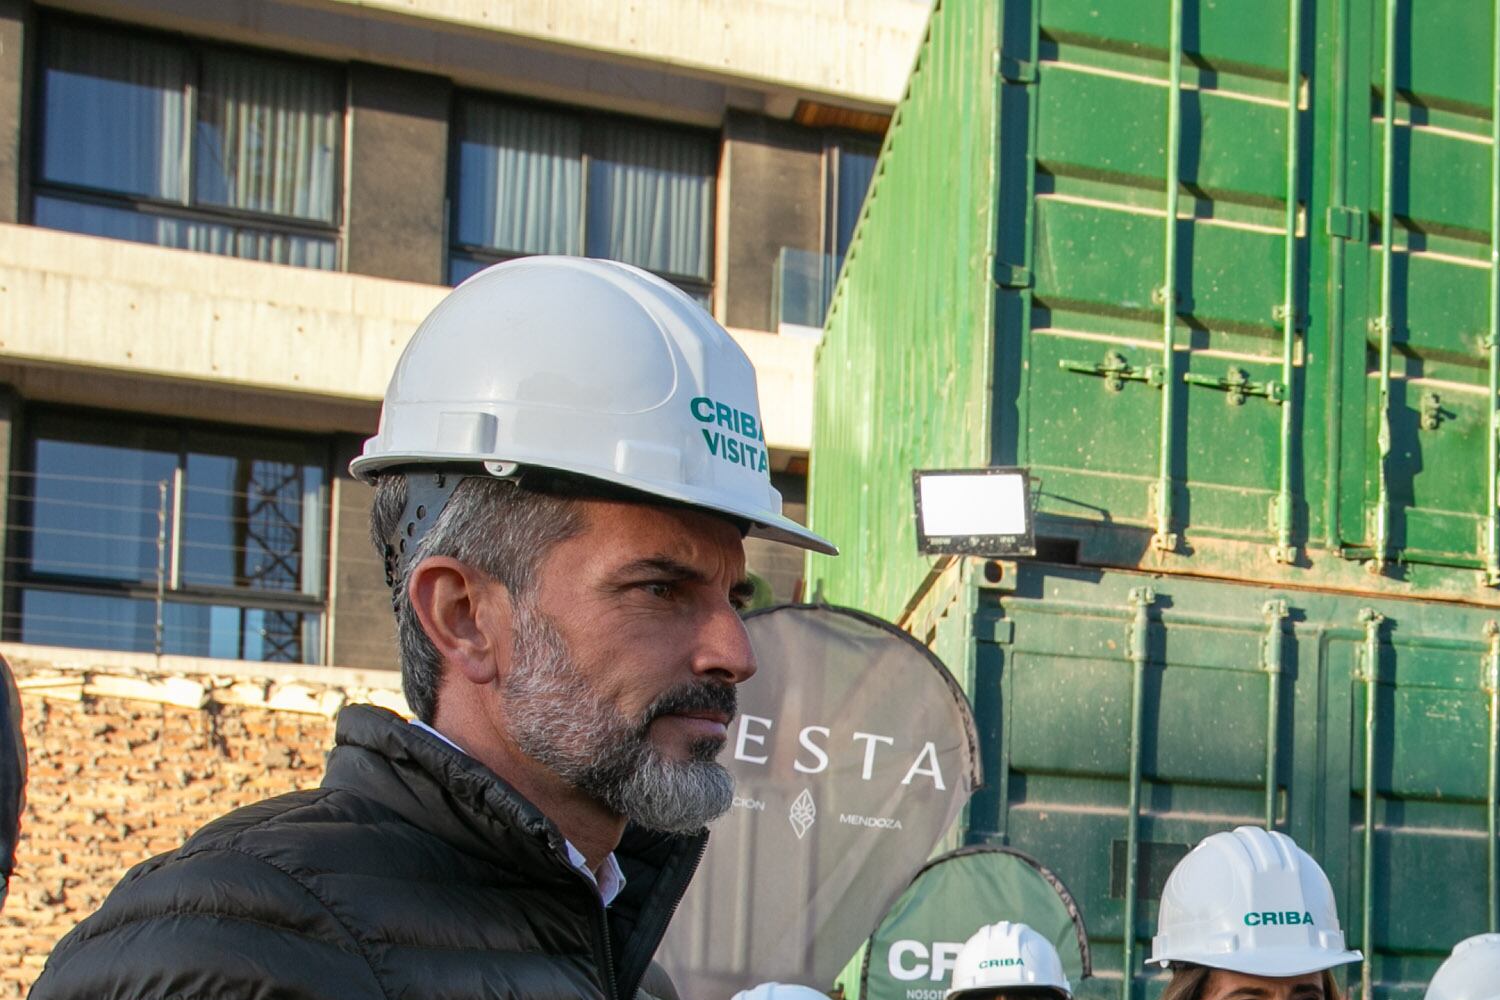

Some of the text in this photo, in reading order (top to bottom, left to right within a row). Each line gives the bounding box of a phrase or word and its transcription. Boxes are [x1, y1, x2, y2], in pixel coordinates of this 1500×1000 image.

[702, 428, 768, 473] VISITA
[839, 813, 903, 831] MENDOZA
[1244, 911, 1315, 926] CRIBA
[978, 957, 1025, 969] CRIBA
